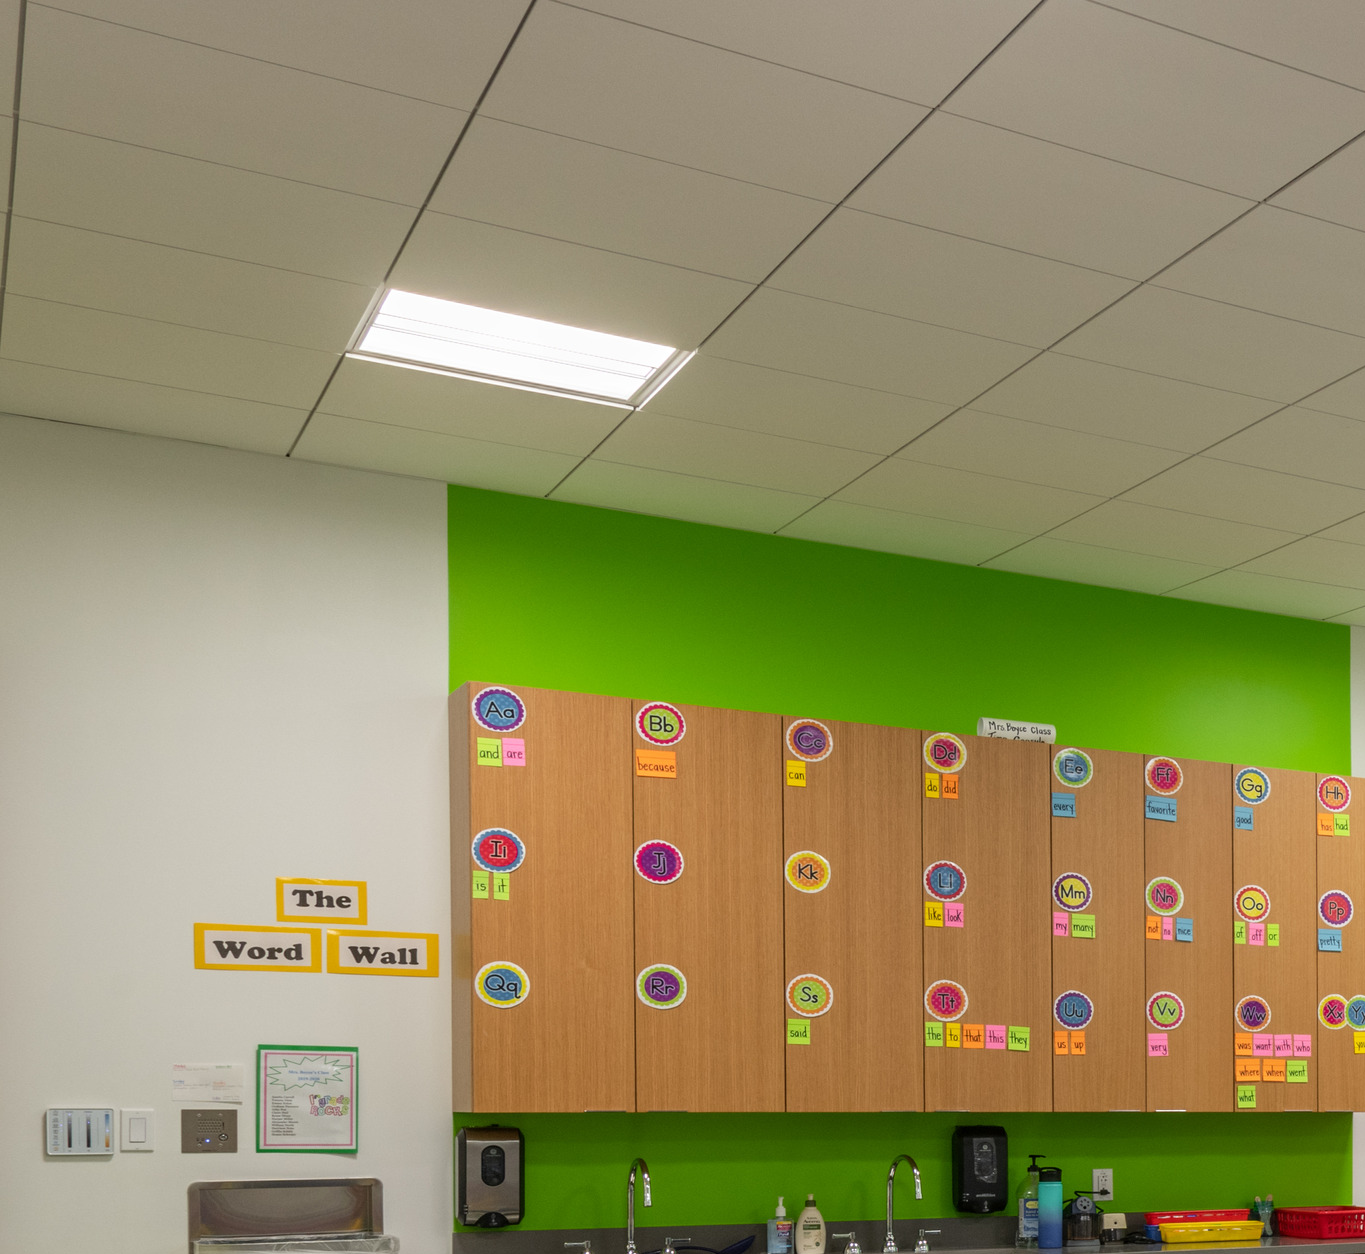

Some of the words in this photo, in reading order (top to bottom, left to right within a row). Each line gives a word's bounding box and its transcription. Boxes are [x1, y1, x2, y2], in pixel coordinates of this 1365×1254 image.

[485, 702, 515, 720] Aa
[649, 716, 674, 733] Bb
[1031, 727, 1051, 735] Class
[480, 748, 499, 760] and
[506, 749, 523, 760] are
[638, 761, 675, 774] because
[788, 771, 804, 780] can
[1326, 786, 1344, 799] Hh
[1054, 801, 1075, 814] every
[1147, 803, 1176, 816] favorite
[1236, 815, 1252, 826] good
[652, 853, 667, 874] Jj
[1061, 885, 1085, 899] Mm
[292, 889, 352, 908] The
[927, 908, 941, 920] like
[947, 910, 962, 922] look
[1073, 923, 1093, 935] many
[1320, 937, 1340, 948] pretty
[213, 940, 304, 960] Word
[348, 946, 419, 965] Wall
[652, 979, 673, 995] Rr
[800, 987, 818, 1003] Ss
[1242, 1008, 1266, 1020] Ww
[790, 1026, 807, 1038] said
[965, 1032, 982, 1042] that
[1010, 1033, 1028, 1046] they
[1150, 1042, 1166, 1054] very
[1239, 1066, 1259, 1076] where
[1239, 1093, 1255, 1103] what
